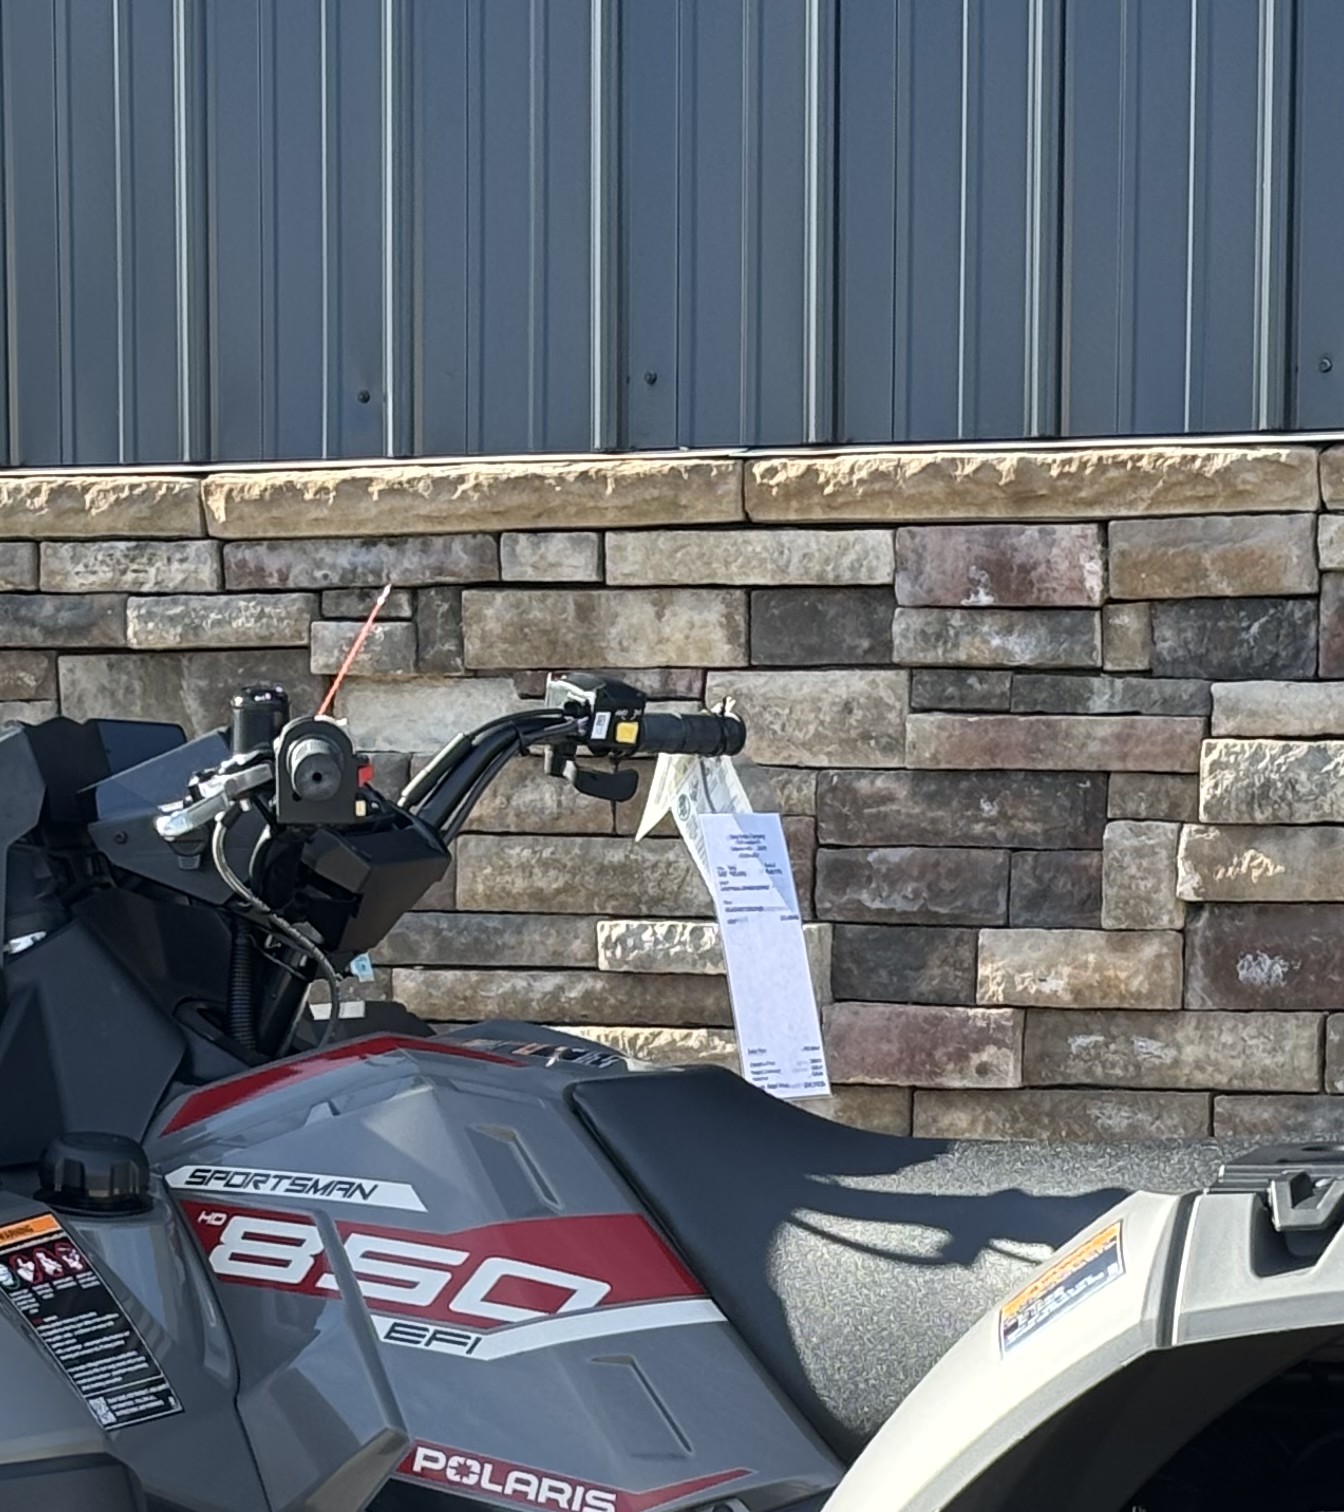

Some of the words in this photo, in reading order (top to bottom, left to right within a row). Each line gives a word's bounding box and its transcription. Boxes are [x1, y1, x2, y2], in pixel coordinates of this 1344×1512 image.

[185, 1168, 378, 1200] SPORTSMAN
[197, 1210, 227, 1226] HD
[208, 1215, 612, 1324] 850
[383, 1321, 482, 1355] EFI
